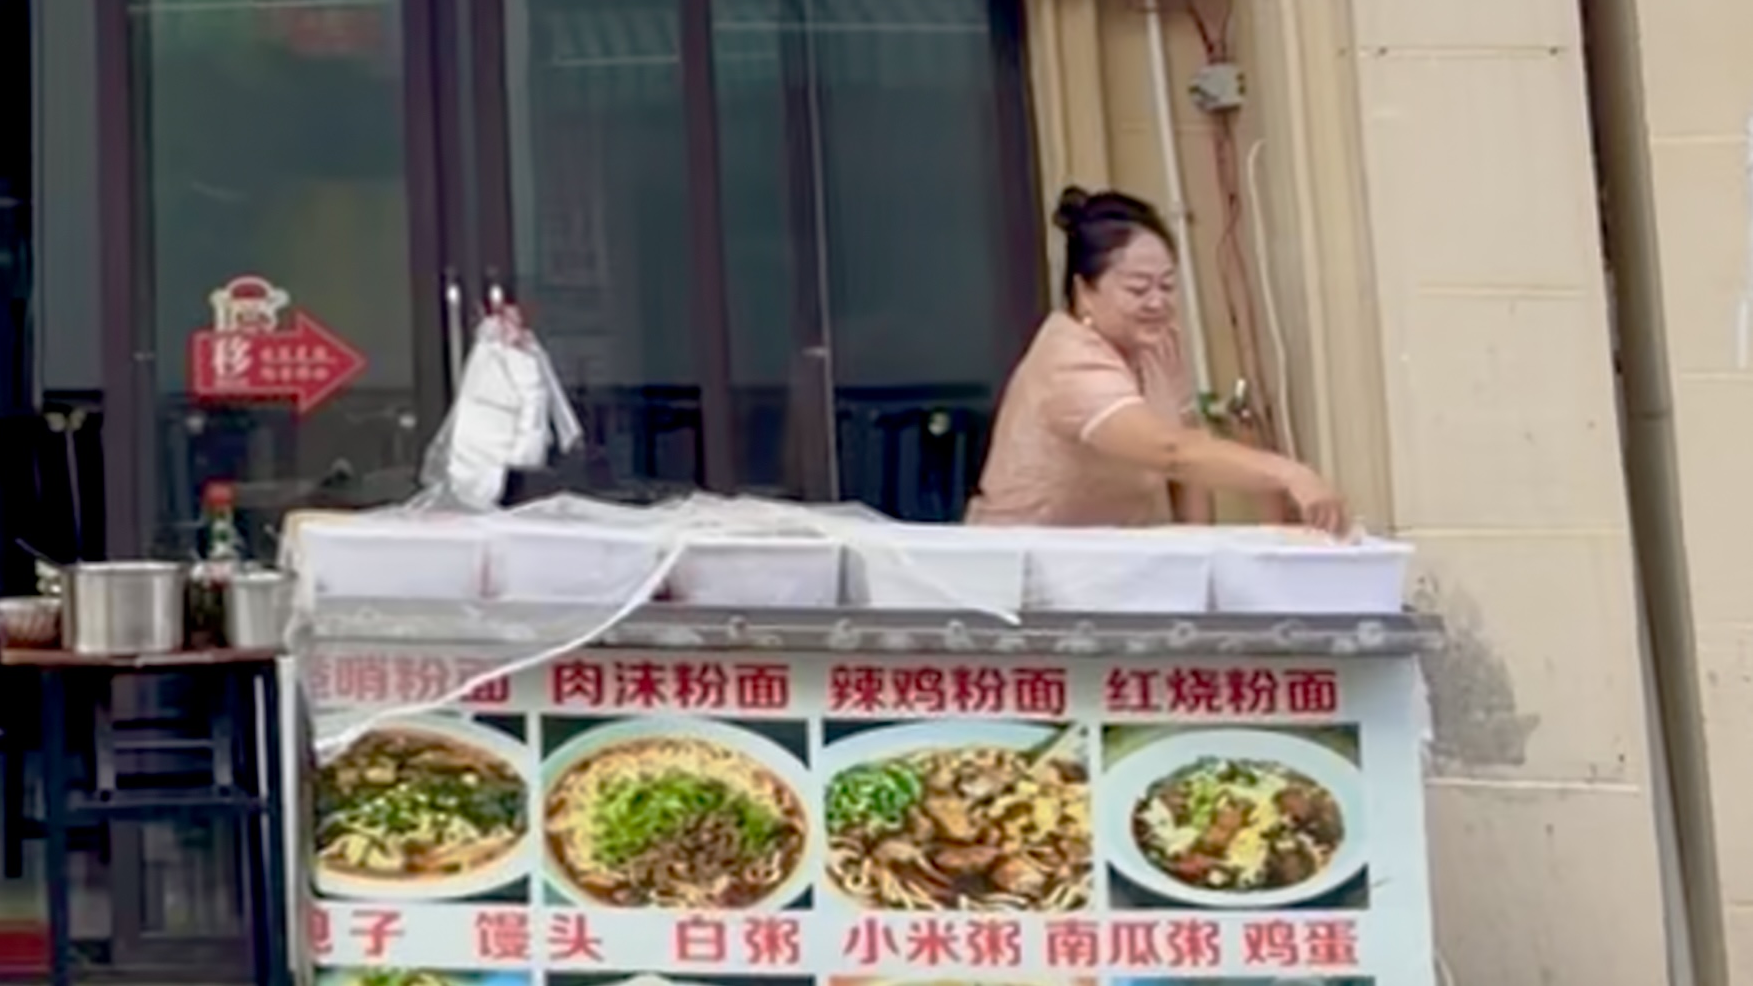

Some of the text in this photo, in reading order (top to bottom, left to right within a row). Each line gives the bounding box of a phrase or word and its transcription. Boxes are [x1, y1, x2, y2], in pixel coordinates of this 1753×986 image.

[552, 663, 789, 709] 肉沫粉面
[828, 667, 1067, 714] 辣鸡粉面
[1105, 668, 1338, 714] 红烧粉面
[475, 910, 604, 962] 馒头
[675, 914, 800, 963] 白粥
[844, 919, 1022, 966] 小米粥
[1046, 920, 1221, 968] 南瓜粥
[1243, 920, 1359, 968] 鸡蛋
